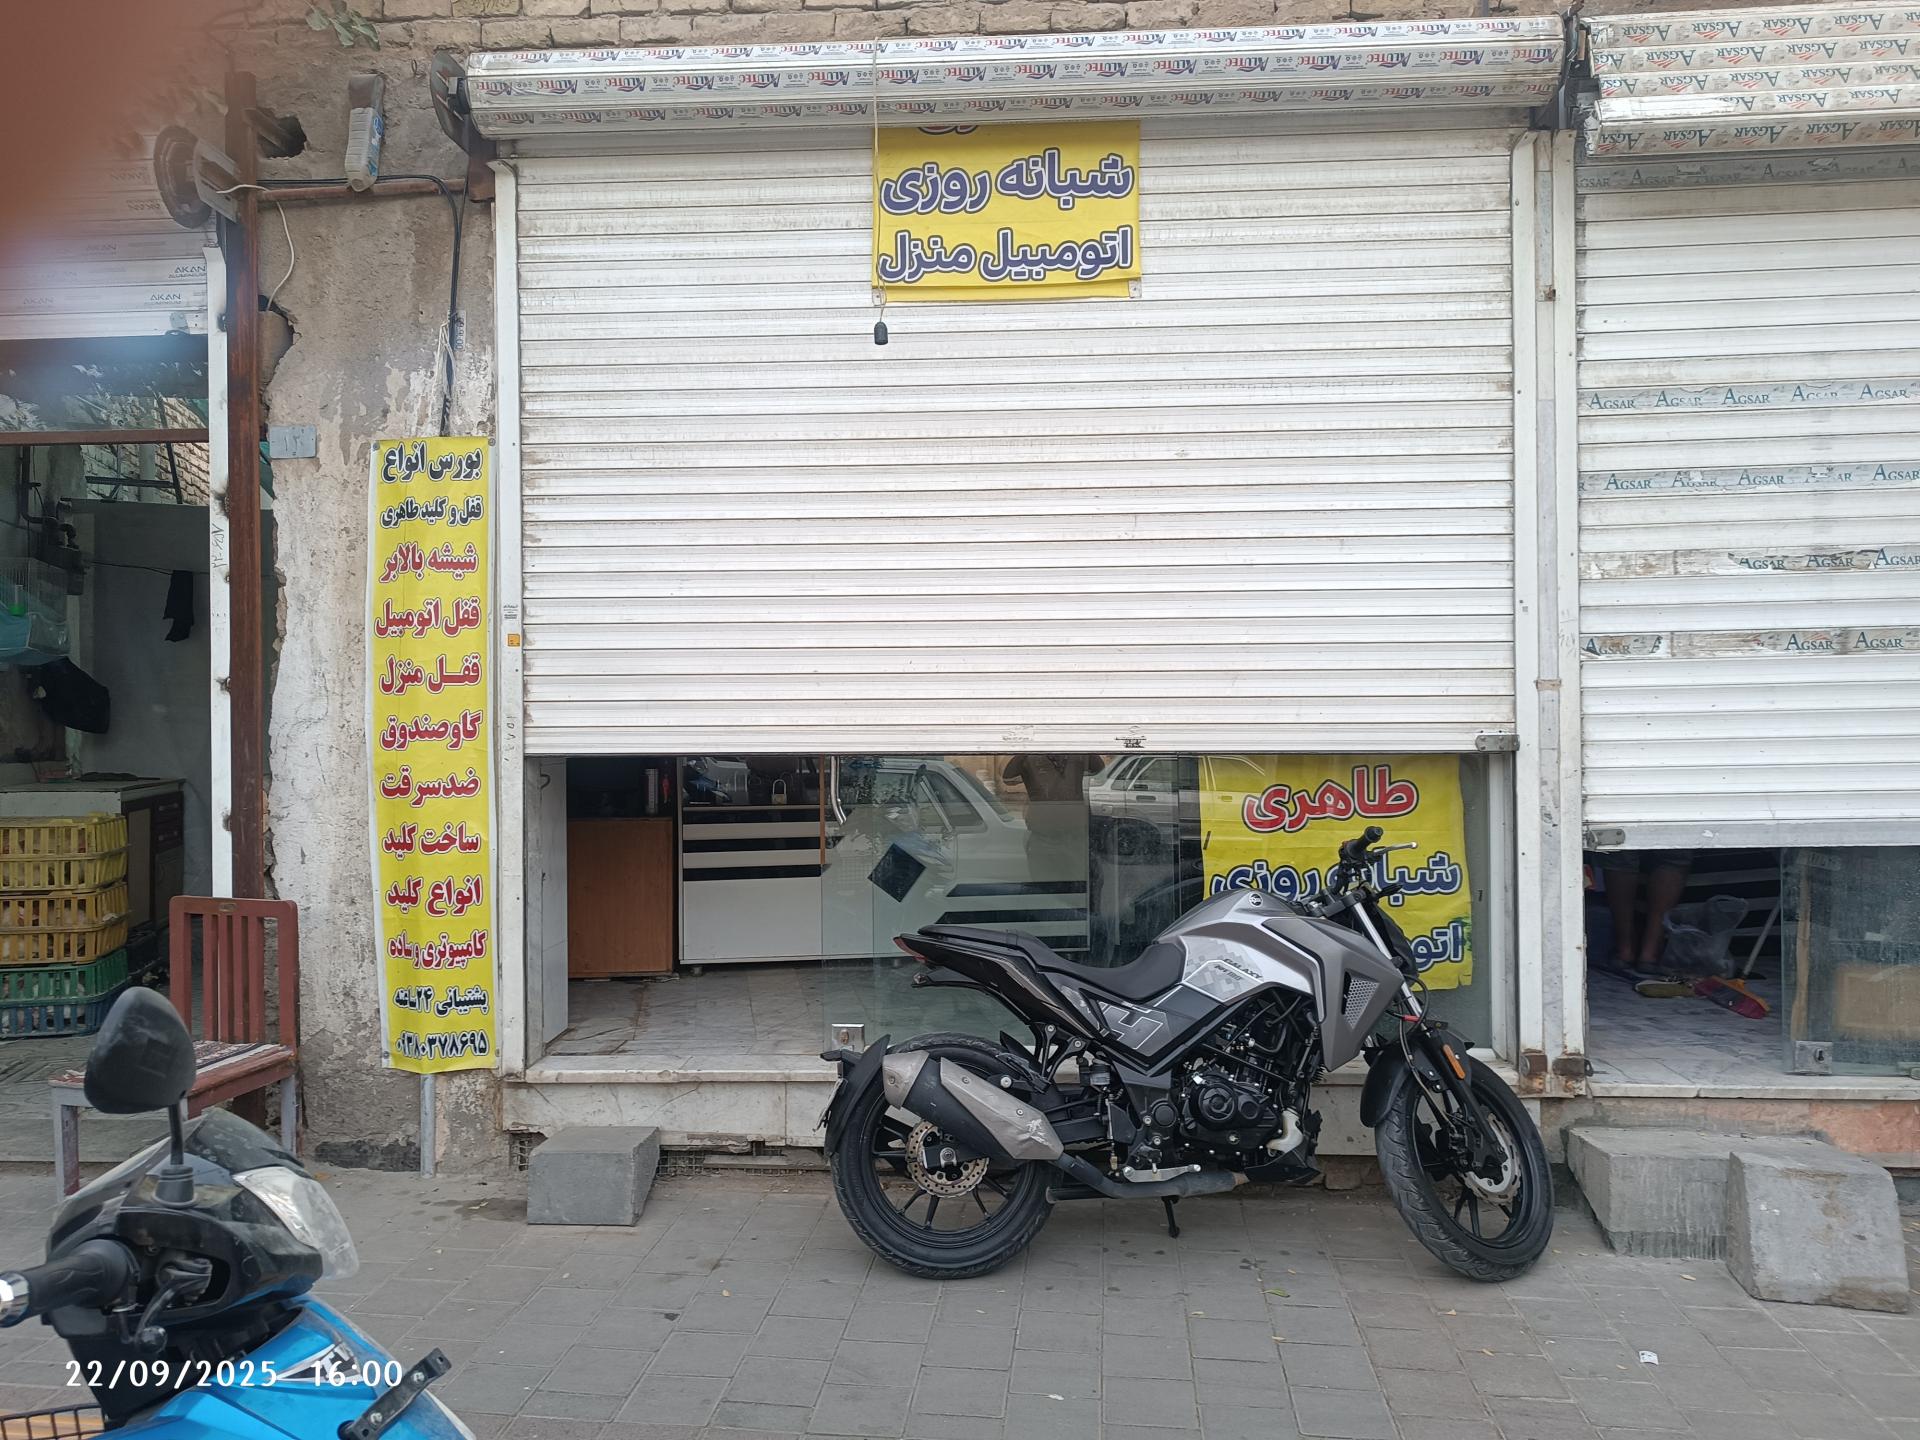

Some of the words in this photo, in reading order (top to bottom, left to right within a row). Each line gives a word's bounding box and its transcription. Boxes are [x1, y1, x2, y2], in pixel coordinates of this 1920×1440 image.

[1622, 24, 1672, 42] AGSAR
[1692, 21, 1742, 38] AGSAR
[1762, 18, 1814, 34] AGSAR
[1834, 14, 1884, 30] AGSAR
[1646, 50, 1696, 66] AGSAR
[1716, 46, 1766, 62] AGSAR
[1786, 42, 1838, 58] AGSAR
[1858, 39, 1910, 55] AGSAR
[537, 78, 578, 94] ALUTEC
[606, 76, 646, 92] ALUTEC
[674, 74, 715, 90] ALUTEC
[739, 72, 781, 88] ALUTEC
[808, 71, 850, 86] ALUTEC
[876, 69, 920, 84] ALUTEC
[945, 66, 987, 82] ALUTEC
[1014, 64, 1057, 79] ALUTEC
[1085, 62, 1129, 78] ALUTEC
[1153, 58, 1197, 74] ALUTEC
[1225, 57, 1269, 72] ALUTEC
[1298, 54, 1342, 70] ALUTEC
[1367, 52, 1411, 68] ALUTEC
[1440, 50, 1484, 65] ALUTEC
[1513, 48, 1559, 64] ALUTEC
[1660, 75, 1710, 91] AGSAR
[1730, 72, 1781, 87] AGSAR
[1801, 68, 1853, 83] AGSAR
[1776, 93, 1829, 107] AGSAR
[1848, 89, 1902, 104] AGSAR
[1664, 129, 1716, 147] AGSAR
[1735, 126, 1788, 143] AGSAR
[1806, 122, 1861, 140] AGSAR
[881, 162, 992, 215] روزی
[995, 147, 1134, 210] شبانه
[174, 266, 206, 274] AKAN
[879, 229, 976, 284] منزل
[979, 225, 1133, 283] اتومبیل
[150, 293, 182, 301] AKAN
[1589, 392, 1637, 410] AGSAR
[1722, 388, 1771, 405] AGSAR
[382, 441, 428, 483] انواع
[428, 448, 483, 482] بورس
[1603, 473, 1652, 490] AGSAR
[1736, 468, 1786, 486] AGSAR
[380, 495, 420, 528] طاهری
[420, 496, 448, 525] کلید
[447, 506, 459, 526] و
[459, 495, 484, 526] قفل
[379, 542, 425, 583] بالابر
[427, 541, 480, 580] شیشه
[374, 598, 441, 638] اتومبیل
[442, 596, 482, 638] قفل
[1784, 634, 1836, 650] AGSAR
[1852, 632, 1904, 649] AGSAR
[379, 653, 424, 695] منزل
[380, 709, 483, 750] گاوصندوق
[1242, 764, 1420, 832] طاهری
[382, 822, 418, 860] کلید
[420, 821, 480, 854] ساخت
[386, 875, 423, 914] کلید
[425, 874, 483, 917] انواع
[388, 928, 414, 958] ساده
[412, 942, 420, 969] و
[422, 929, 488, 969] کامپیوتری
[434, 985, 489, 1017] پشتیبانی
